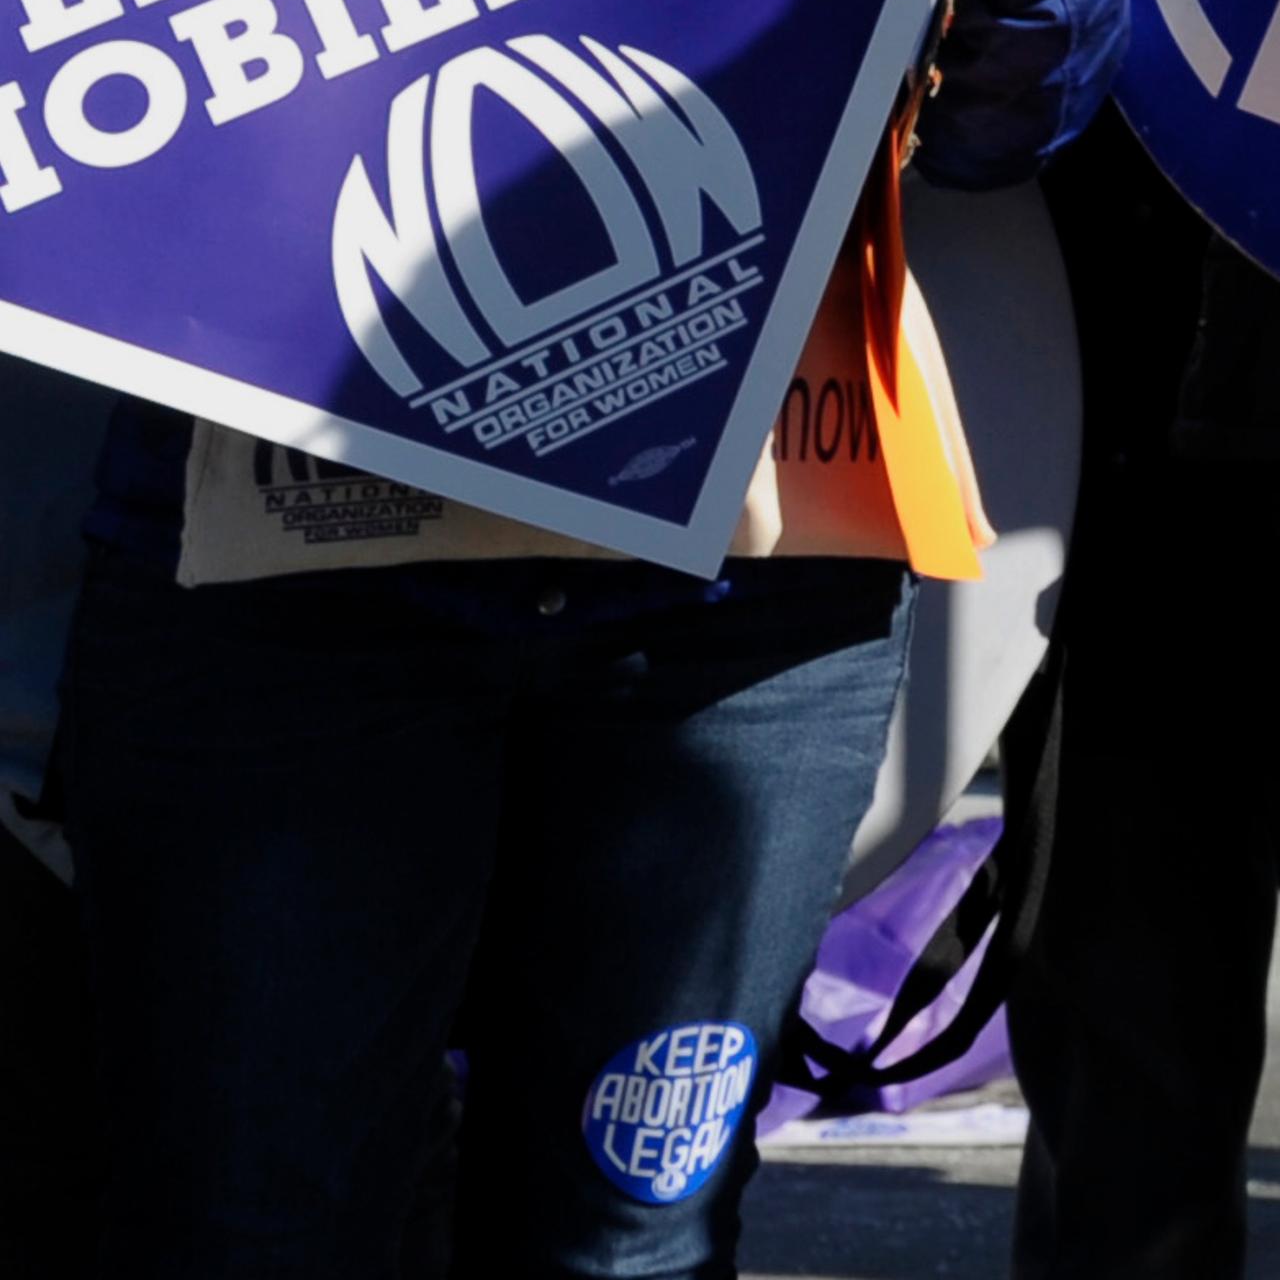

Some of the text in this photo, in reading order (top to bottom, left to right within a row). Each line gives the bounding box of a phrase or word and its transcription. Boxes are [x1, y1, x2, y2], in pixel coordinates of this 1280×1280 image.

[331, 33, 764, 399] NOW
[431, 257, 760, 427] NATIONAL
[471, 298, 746, 445] ORGANIZATION
[525, 342, 723, 453] FOR WOMEN
[265, 480, 430, 510] NATION
[282, 497, 444, 527] ORGANIZATION
[634, 1024, 746, 1077] KEEP
[592, 1055, 753, 1128] ABORTION
[603, 1116, 731, 1178] LEGAL
